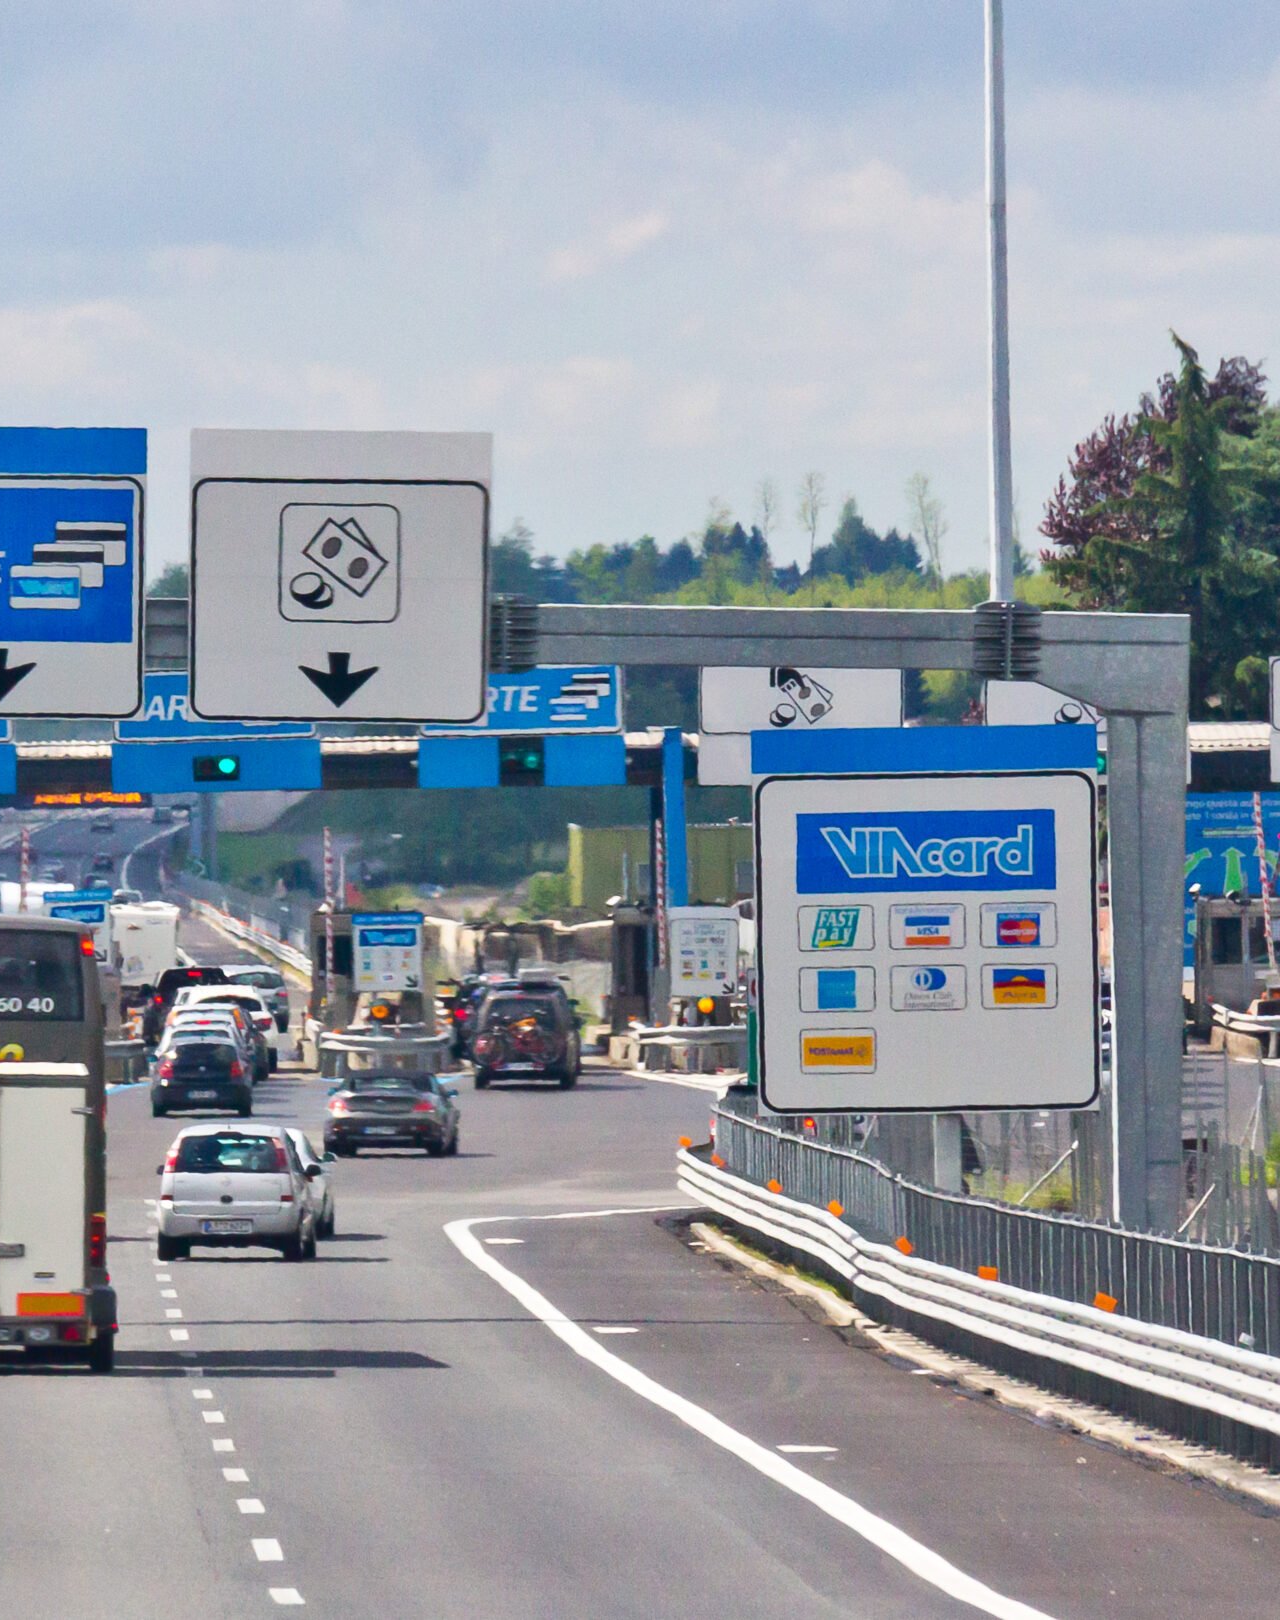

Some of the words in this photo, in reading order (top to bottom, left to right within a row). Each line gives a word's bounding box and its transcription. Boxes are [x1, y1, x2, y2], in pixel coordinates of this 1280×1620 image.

[820, 824, 1033, 879] VIAcard
[818, 911, 857, 927] FAST
[814, 926, 853, 945] pay
[916, 927, 941, 936] VISA
[26, 997, 55, 1013] 40
